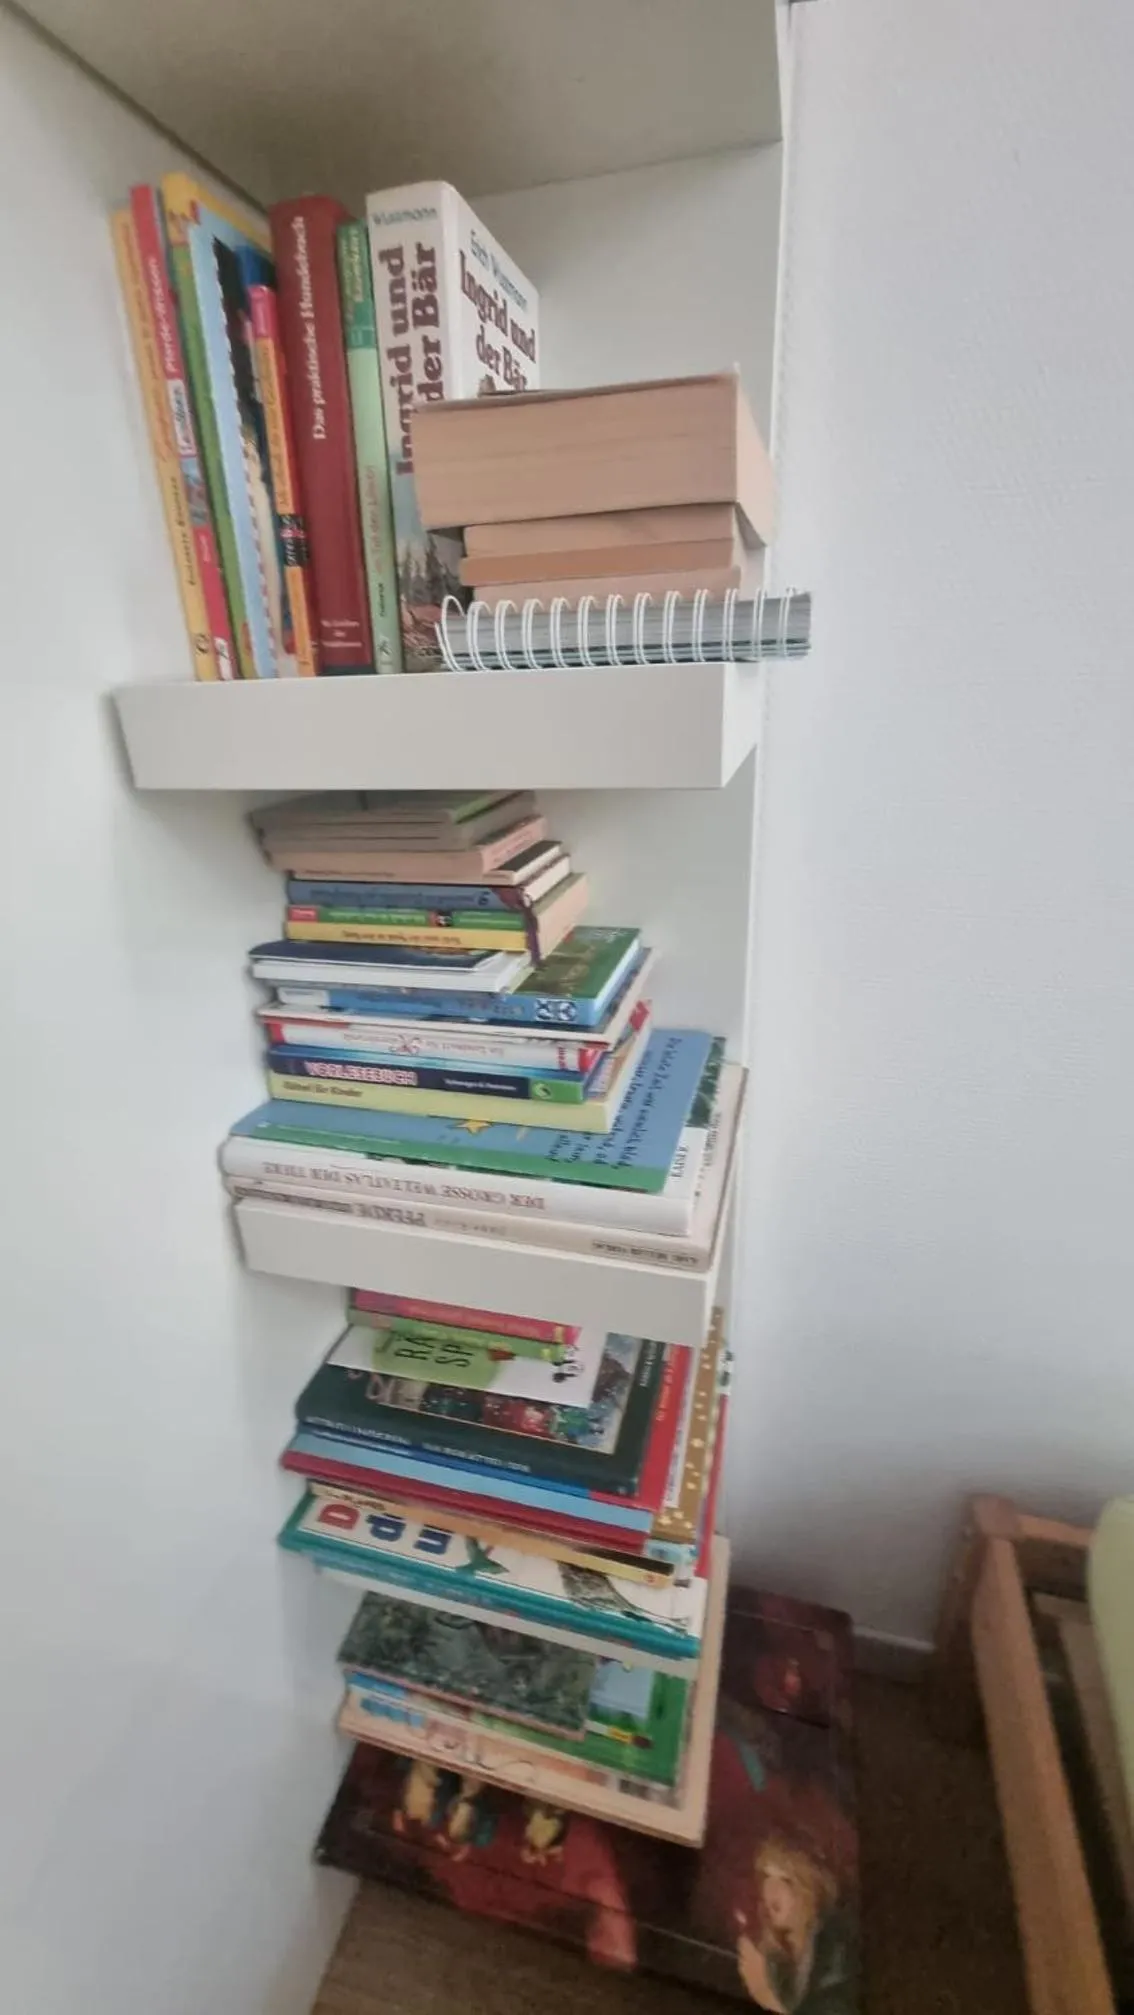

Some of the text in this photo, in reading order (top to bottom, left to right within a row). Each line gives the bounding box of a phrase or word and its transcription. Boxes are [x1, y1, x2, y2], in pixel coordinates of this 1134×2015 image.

[379, 244, 410, 337] und
[459, 248, 536, 363] Ingrid und
[291, 215, 327, 440] Das praktische Hundebuch
[411, 242, 444, 402] der Bär
[476, 324, 500, 376] der
[311, 1167, 340, 1184] DER
[345, 1172, 437, 1198] WELTATLAS
[442, 1184, 506, 1206] GROSSE
[509, 1193, 545, 1211] DER
